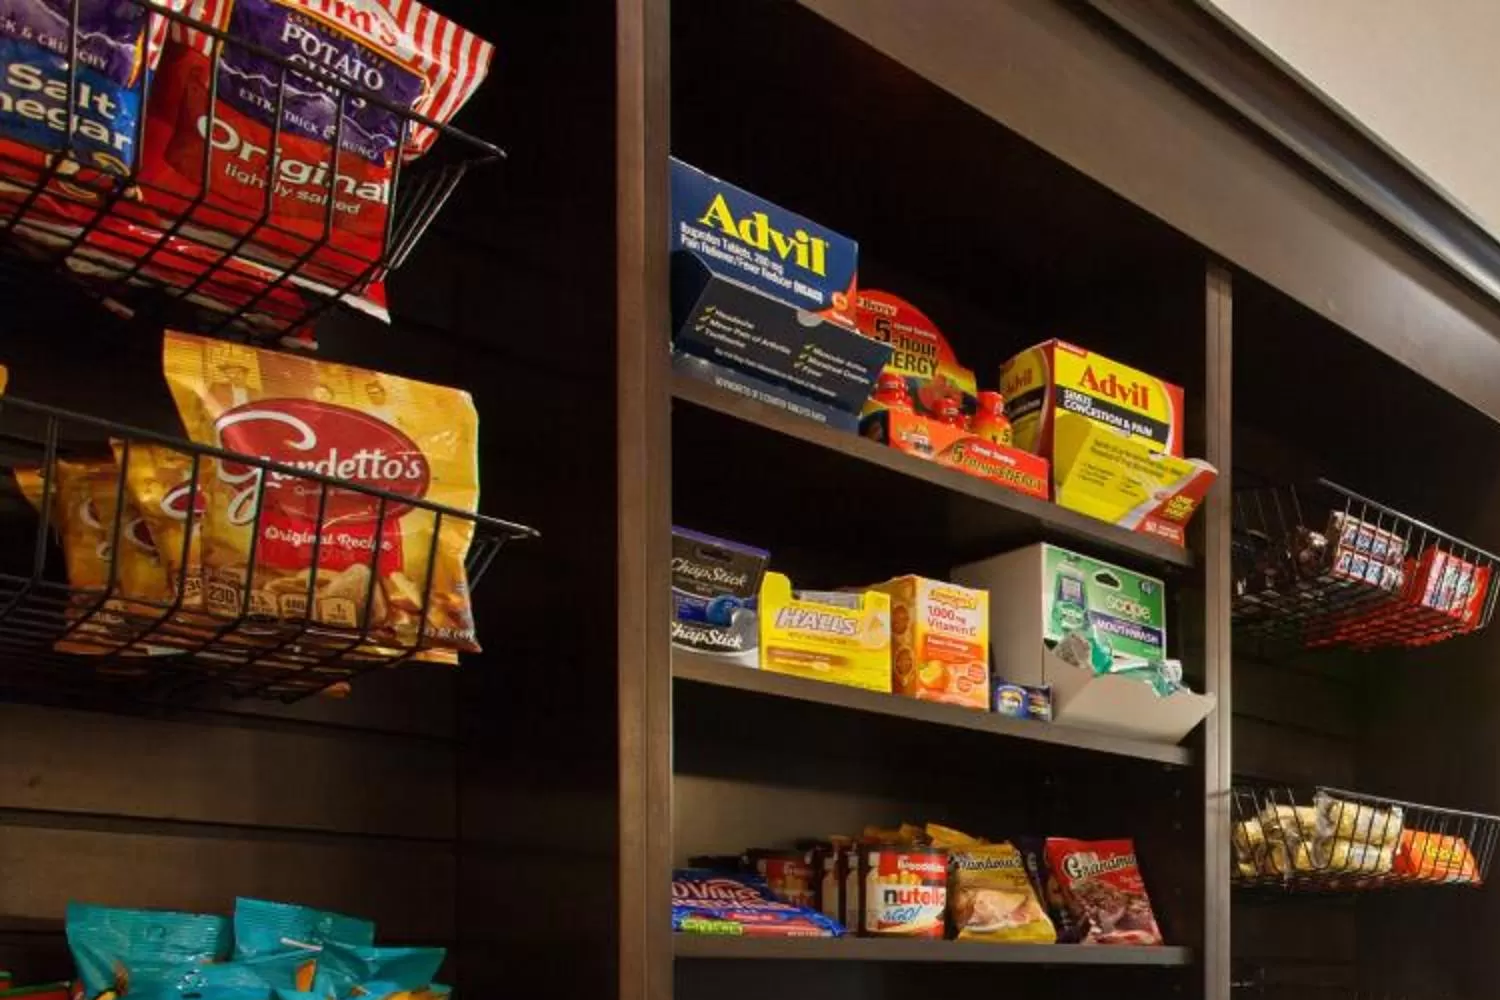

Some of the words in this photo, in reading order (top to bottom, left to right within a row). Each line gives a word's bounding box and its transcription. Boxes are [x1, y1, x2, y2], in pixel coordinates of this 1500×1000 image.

[38, 35, 108, 70] CRUCHY
[281, 22, 384, 91] POTATO
[7, 63, 116, 119] Salt
[239, 87, 276, 114] EXTR
[284, 109, 321, 134] THICK
[0, 91, 132, 150] egar
[197, 115, 391, 205] Original
[224, 163, 293, 197] lighly
[296, 185, 361, 215] saled
[698, 193, 827, 277] Advil
[889, 351, 937, 377] ERGY
[1078, 365, 1149, 411] Advil
[214, 409, 422, 527] Gardetto's
[264, 526, 334, 549] Original
[337, 532, 394, 552] Recie
[775, 606, 858, 637] HALLS
